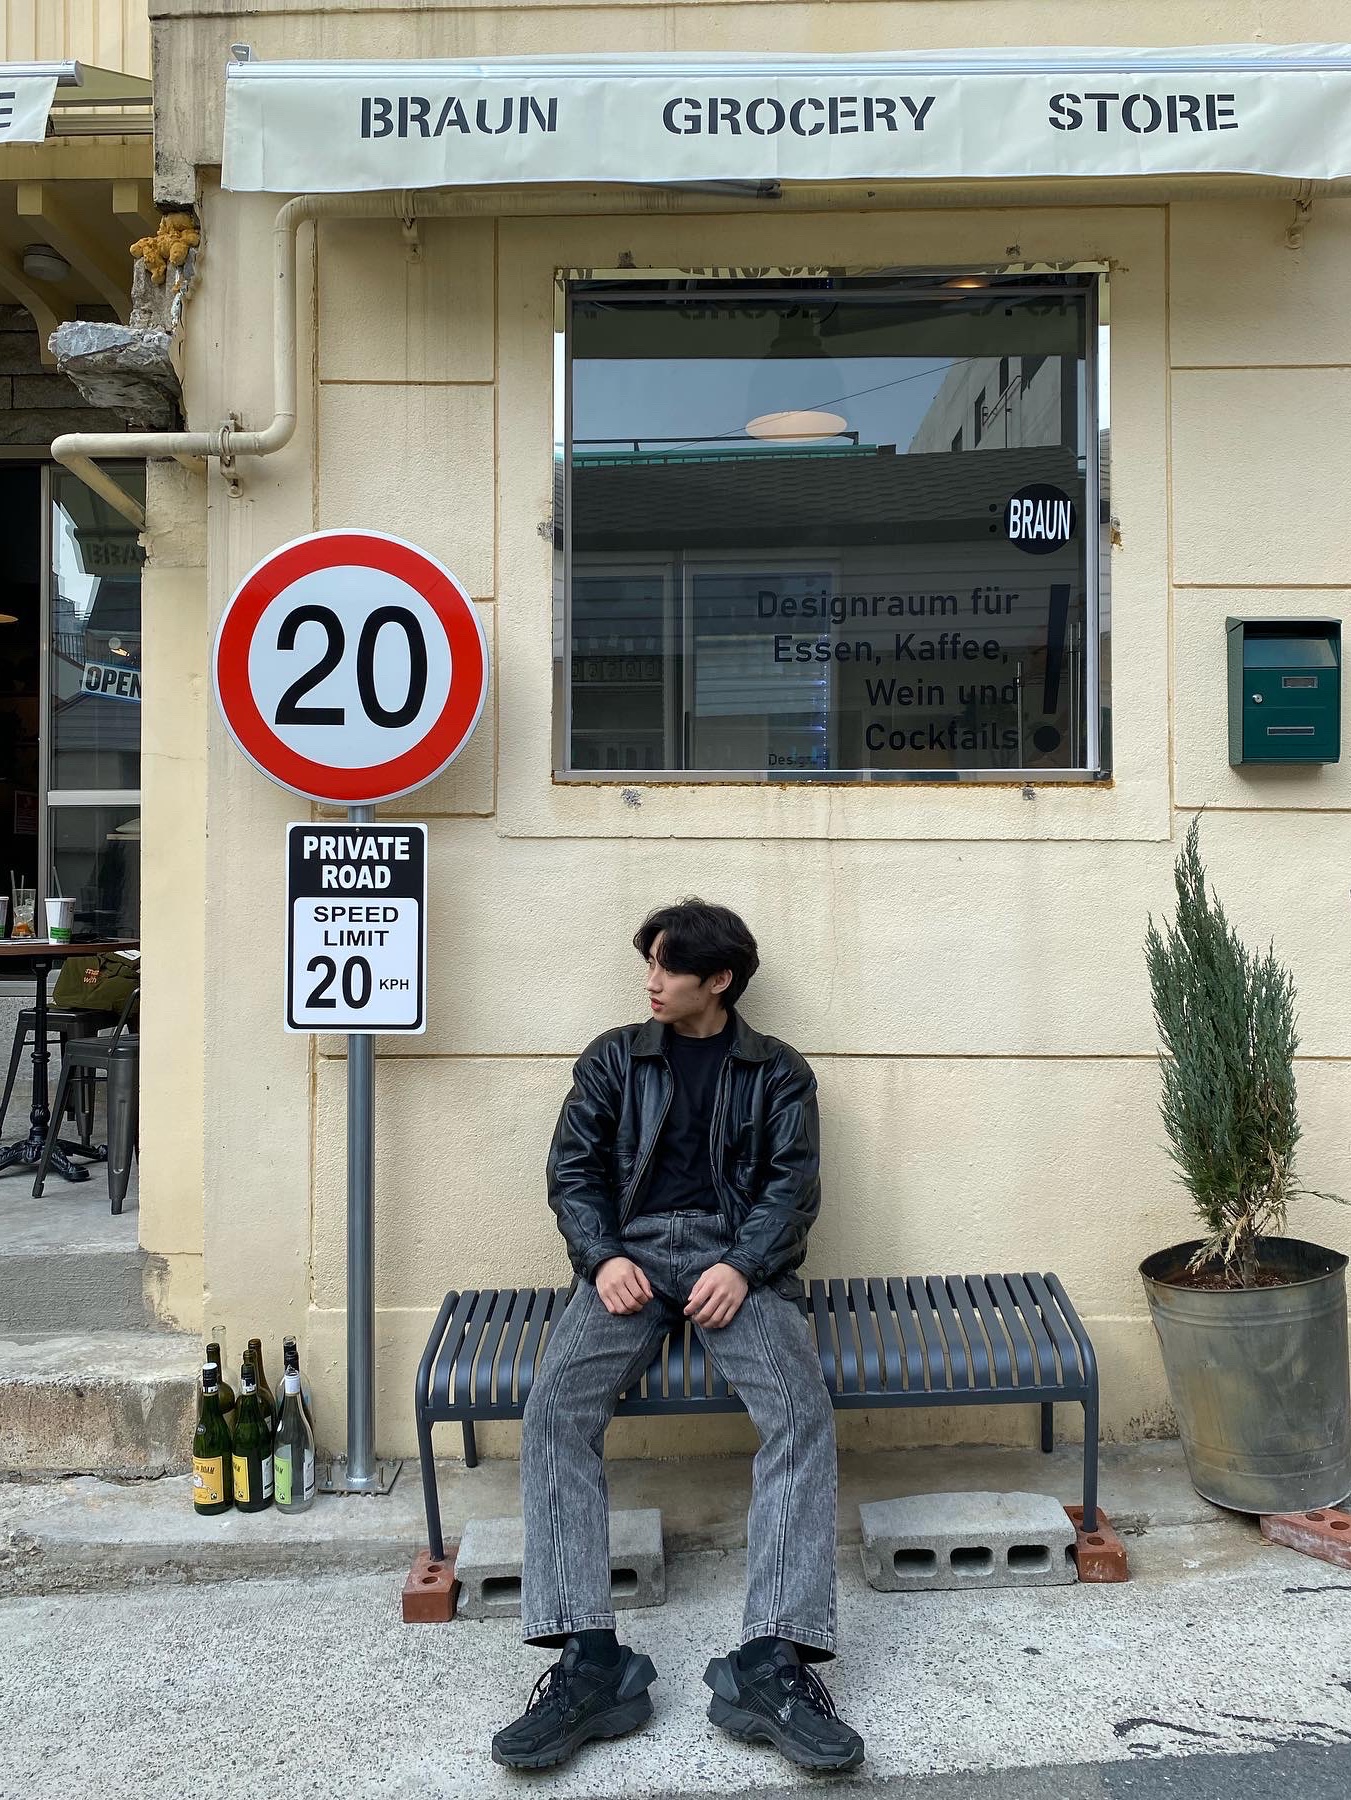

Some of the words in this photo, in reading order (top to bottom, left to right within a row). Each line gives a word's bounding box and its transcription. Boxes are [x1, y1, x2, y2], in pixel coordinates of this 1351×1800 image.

[361, 96, 557, 138] BRAUN
[662, 96, 936, 136] GROCERY
[1048, 93, 1238, 133] STORE
[1009, 499, 1072, 540] BRAUN
[757, 590, 958, 624] Designraum
[971, 587, 1020, 614] für
[774, 635, 882, 666] Essen,
[895, 633, 1008, 665] Kaffee,
[275, 605, 428, 728] 20
[866, 678, 944, 706] Wein
[959, 678, 1018, 705] und
[866, 723, 1019, 751] Cocktails
[303, 836, 410, 861] PRIVATE
[322, 864, 391, 889] ROAD
[314, 906, 399, 923] SPEED
[324, 930, 389, 947] LIMIT
[305, 955, 372, 1009] 20
[379, 978, 410, 990] KPH
